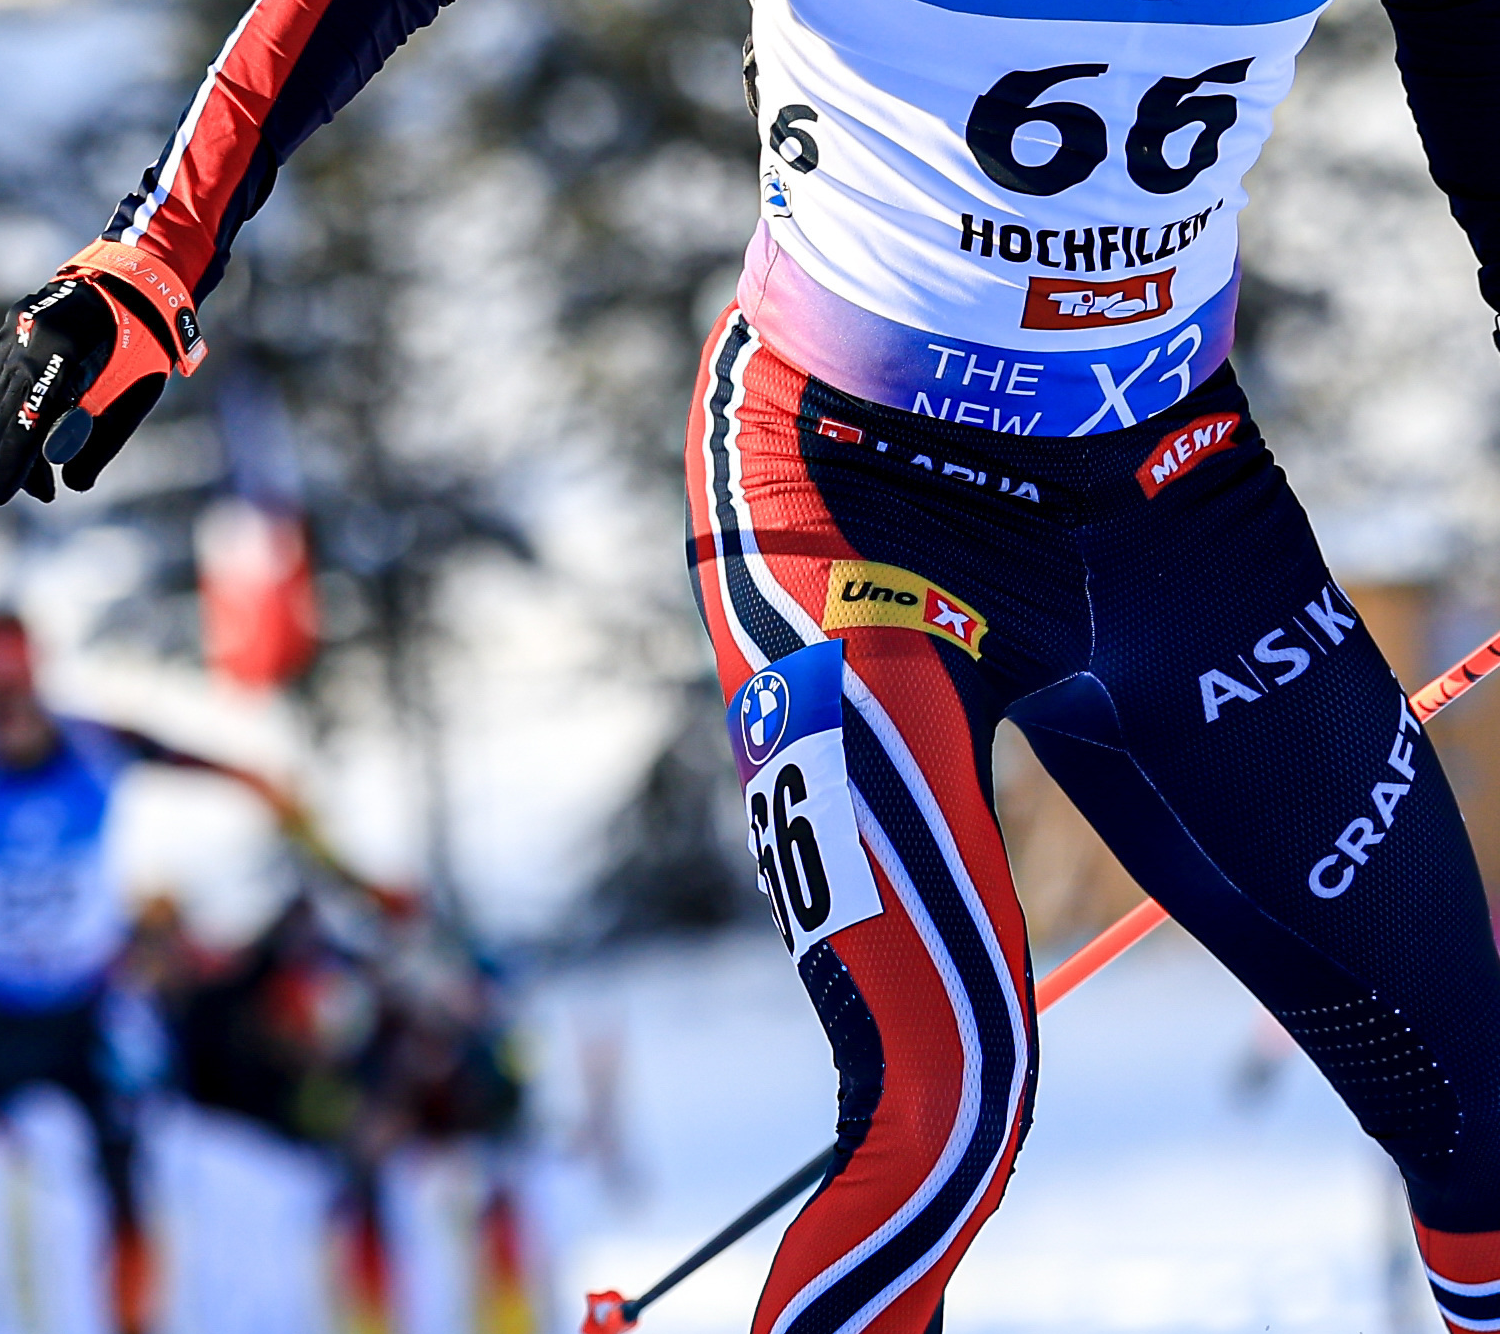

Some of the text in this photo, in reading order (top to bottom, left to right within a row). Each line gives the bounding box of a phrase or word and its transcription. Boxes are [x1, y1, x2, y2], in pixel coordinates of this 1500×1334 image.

[965, 56, 1257, 197] 66
[927, 343, 1045, 396] THE
[1066, 323, 1202, 438] X3
[1150, 420, 1233, 485] MENY
[841, 580, 919, 607] Uno
[743, 677, 781, 713] BMW
[1309, 694, 1422, 899] CRAFT
